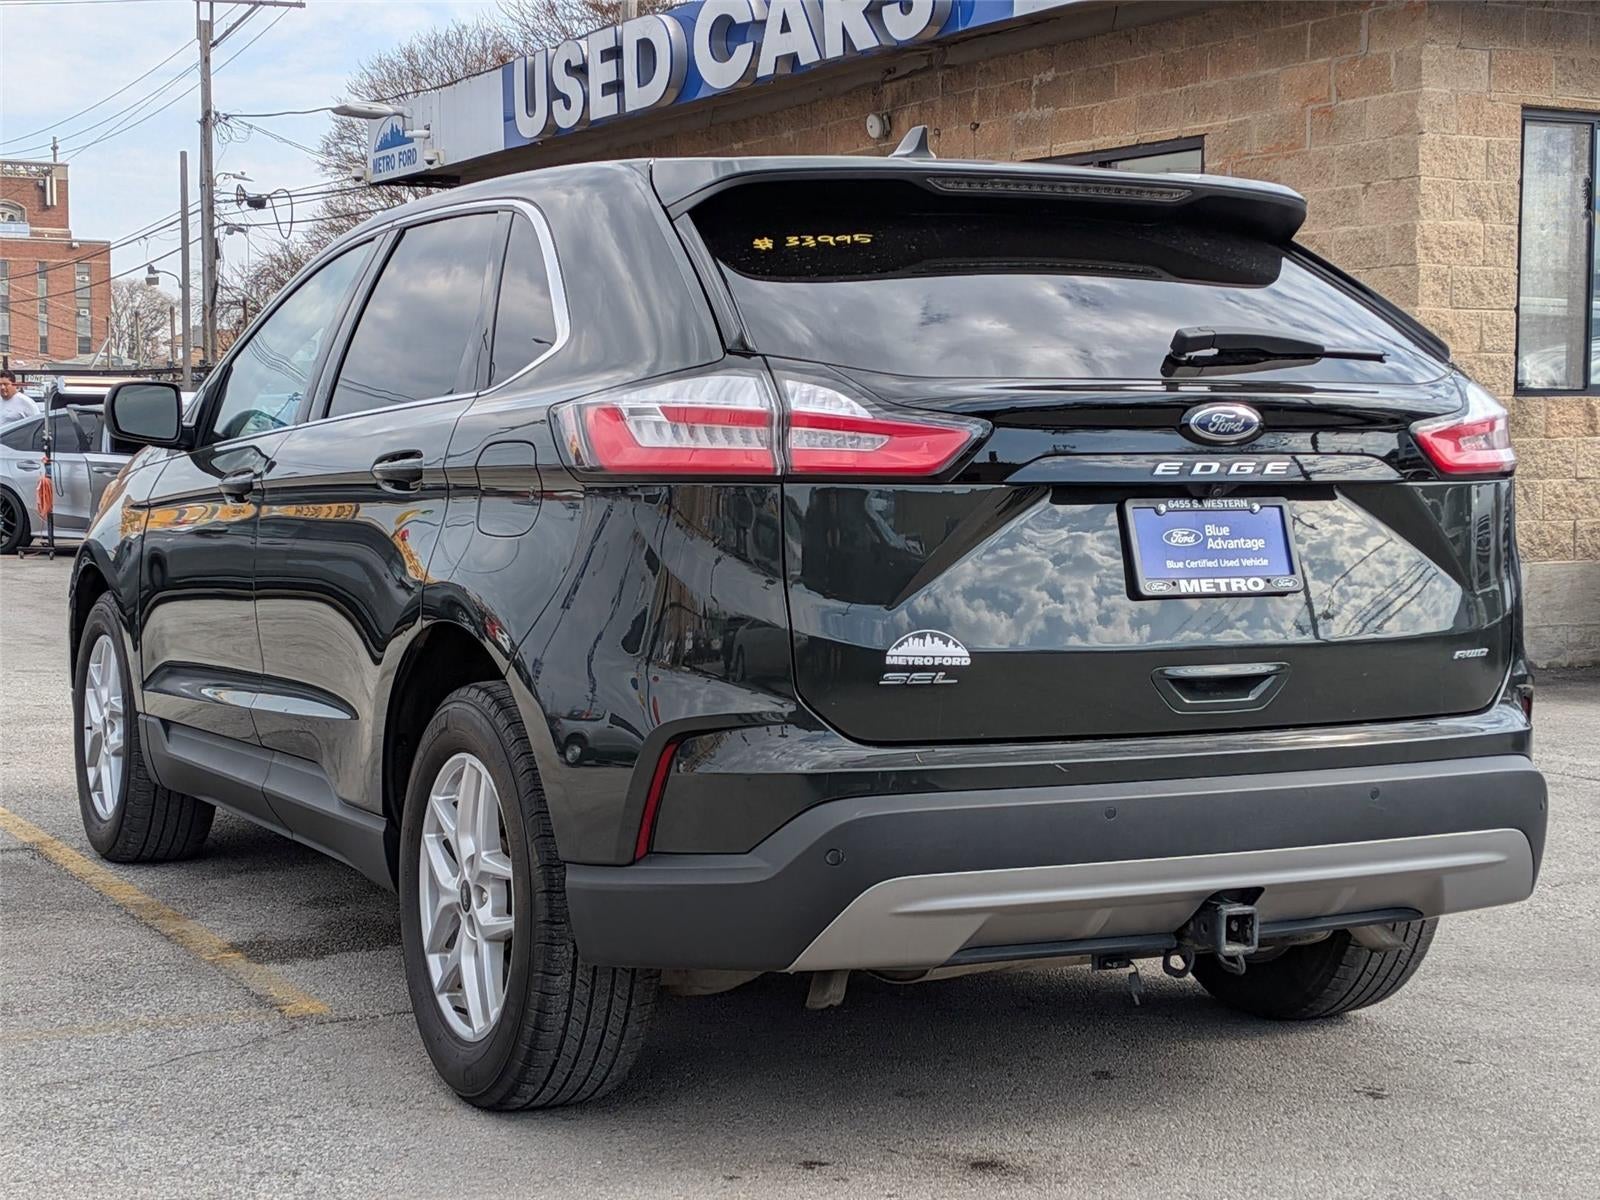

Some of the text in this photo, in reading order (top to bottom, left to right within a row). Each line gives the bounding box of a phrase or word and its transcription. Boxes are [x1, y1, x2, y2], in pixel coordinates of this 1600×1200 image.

[513, 14, 672, 138] USED
[373, 147, 417, 175] METRO FORD
[753, 234, 873, 250] # 33995
[1208, 413, 1245, 432] Ford
[1152, 462, 1291, 475] EDGE
[1168, 499, 1248, 508] 6455 S. WESTERN
[1205, 524, 1230, 536] Blue
[1170, 531, 1196, 543] Ford
[1207, 537, 1265, 551] Advantage
[1166, 557, 1269, 569] Blue Certified Used Vehicle
[1179, 577, 1265, 593] METRO
[1453, 648, 1489, 659] AWD
[879, 672, 958, 684] SEL
